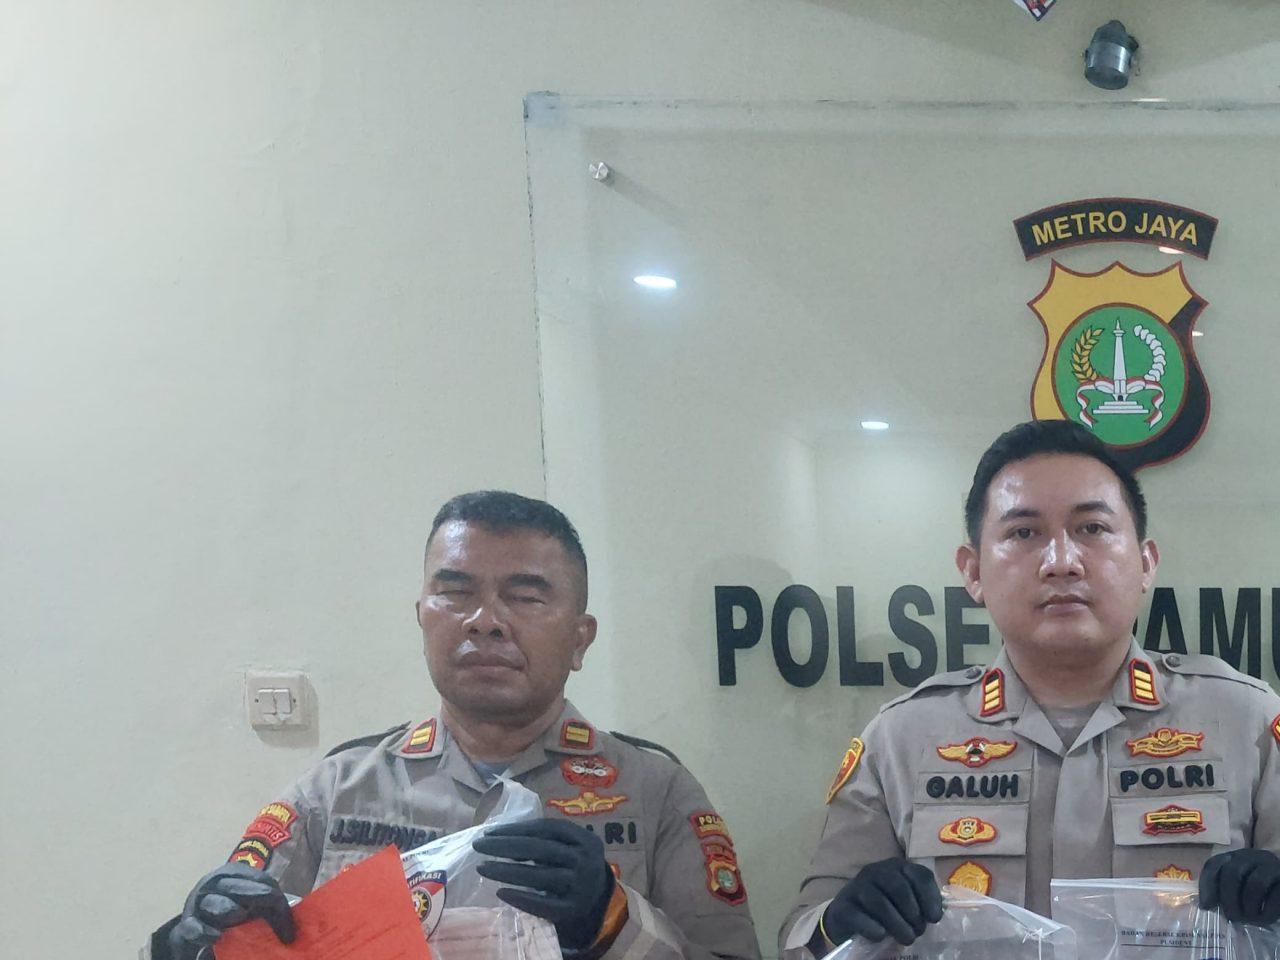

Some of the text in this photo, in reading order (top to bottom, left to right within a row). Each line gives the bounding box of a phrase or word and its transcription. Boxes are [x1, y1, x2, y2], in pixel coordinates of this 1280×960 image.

[1031, 210, 1198, 246] METRO JAYA
[714, 584, 990, 688] POLSE
[926, 772, 1020, 799] GALUH
[1120, 763, 1215, 794] POLRI
